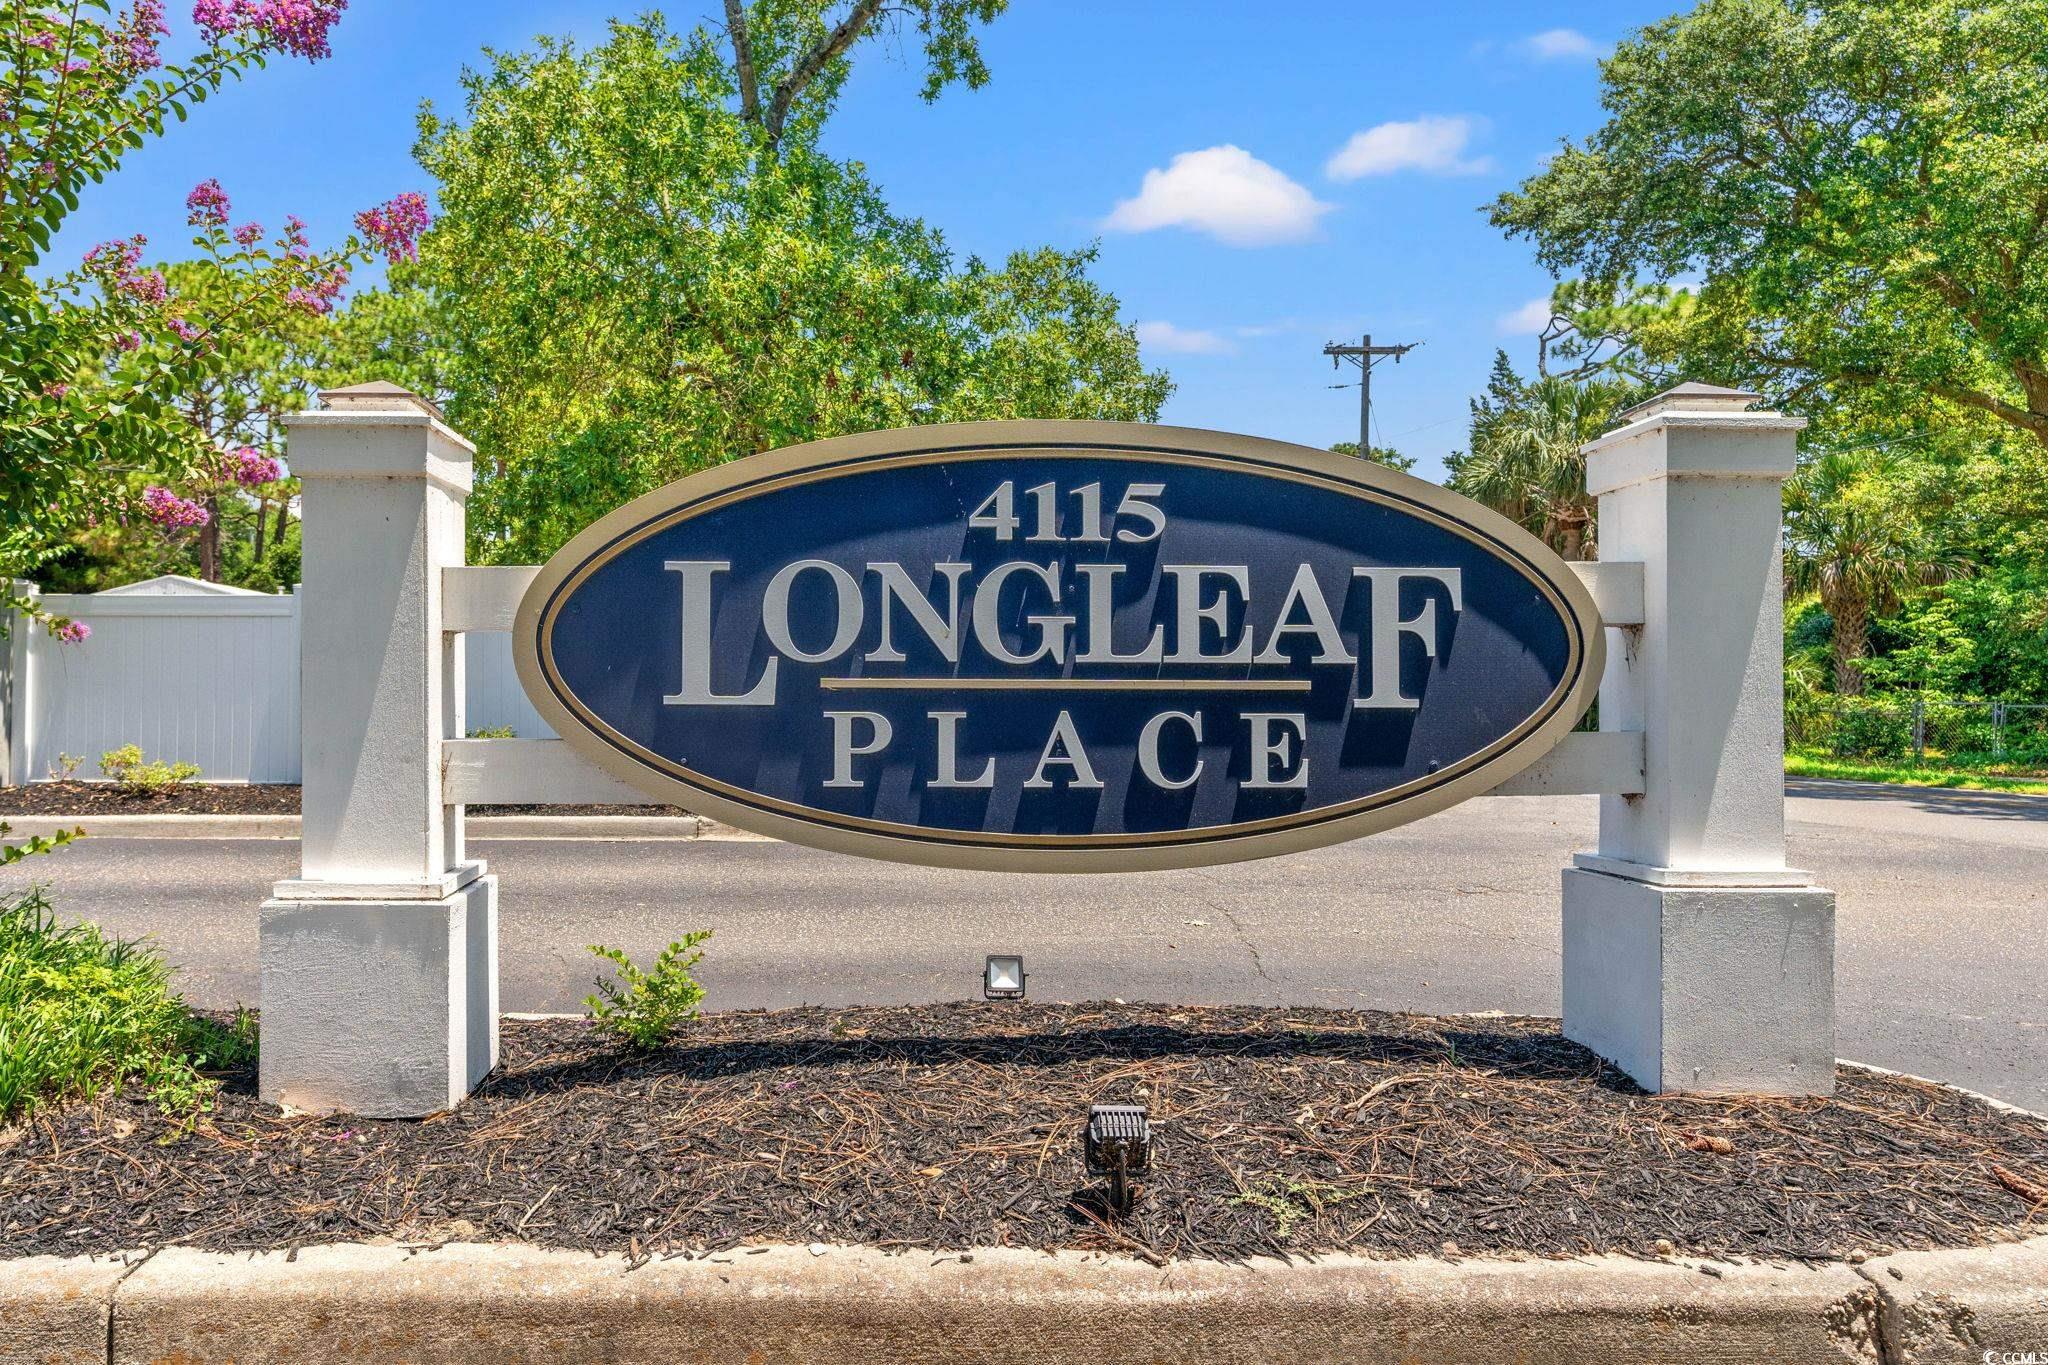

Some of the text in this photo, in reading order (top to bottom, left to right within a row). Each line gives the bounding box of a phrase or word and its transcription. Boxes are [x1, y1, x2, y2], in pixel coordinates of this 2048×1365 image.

[968, 480, 1166, 542] 4115
[663, 559, 1463, 708] LONGLEAF
[822, 710, 1309, 790] PLACE
